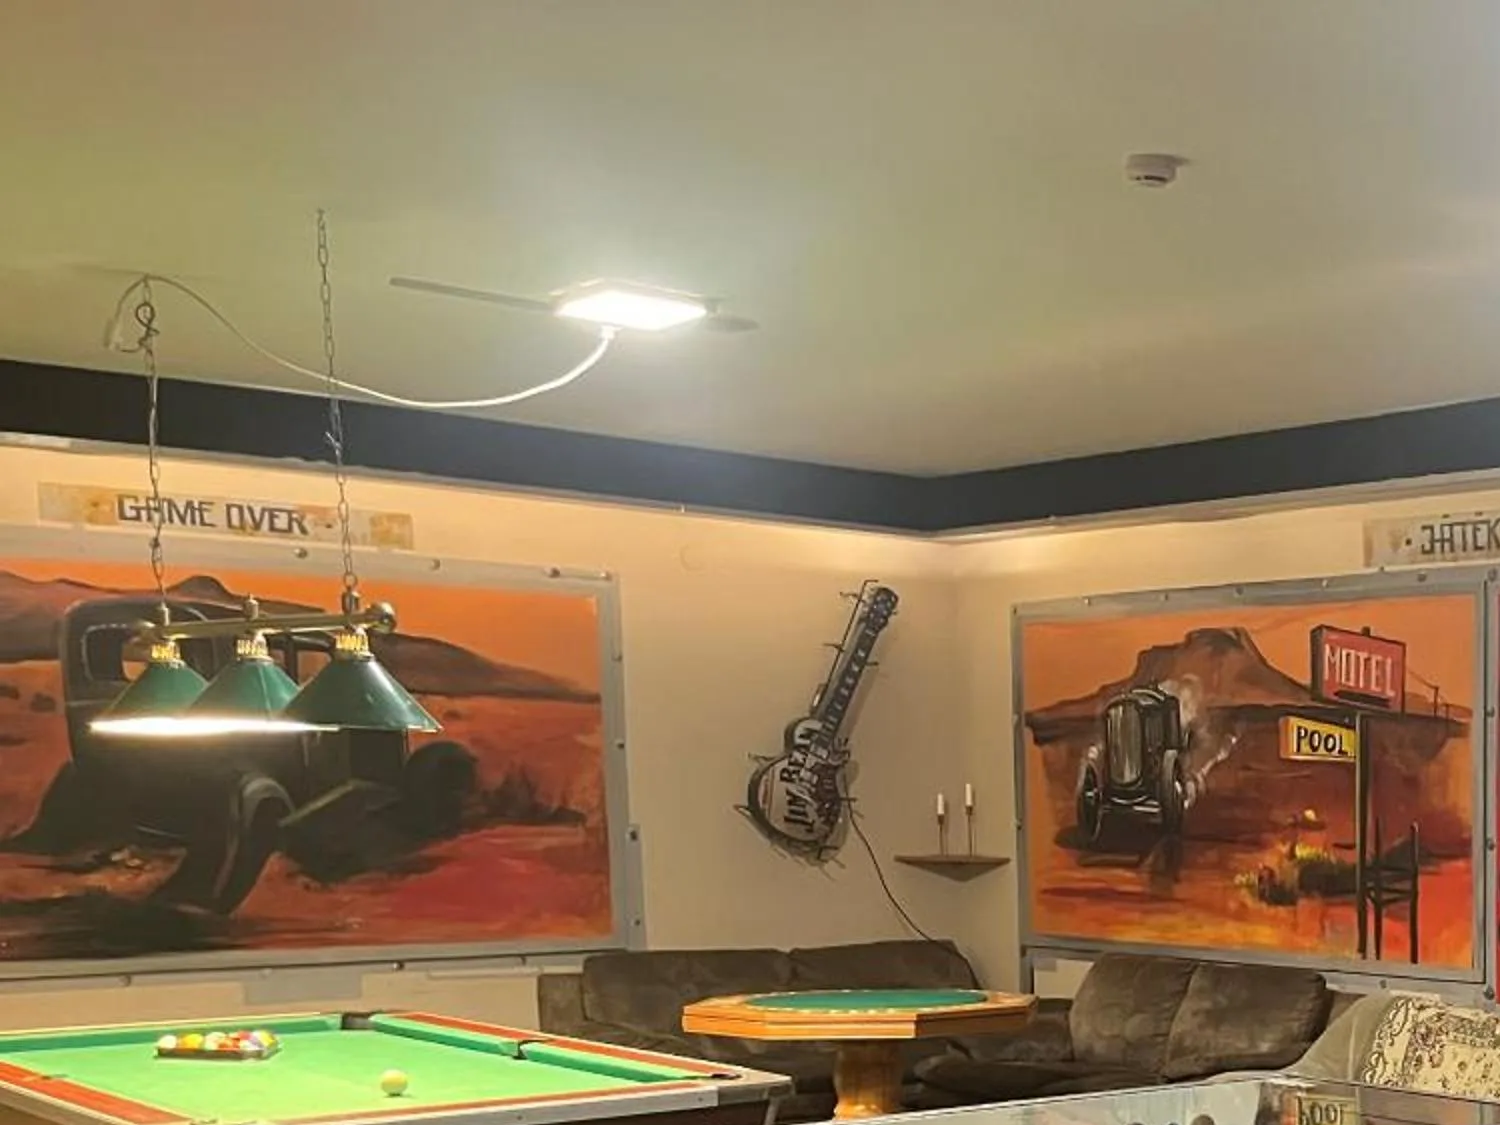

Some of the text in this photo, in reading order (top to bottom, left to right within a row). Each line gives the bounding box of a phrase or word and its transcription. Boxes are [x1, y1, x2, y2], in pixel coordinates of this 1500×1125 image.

[117, 493, 309, 536] GAME OVER
[1324, 643, 1397, 697] MOTEL
[1295, 725, 1349, 756] POOL
